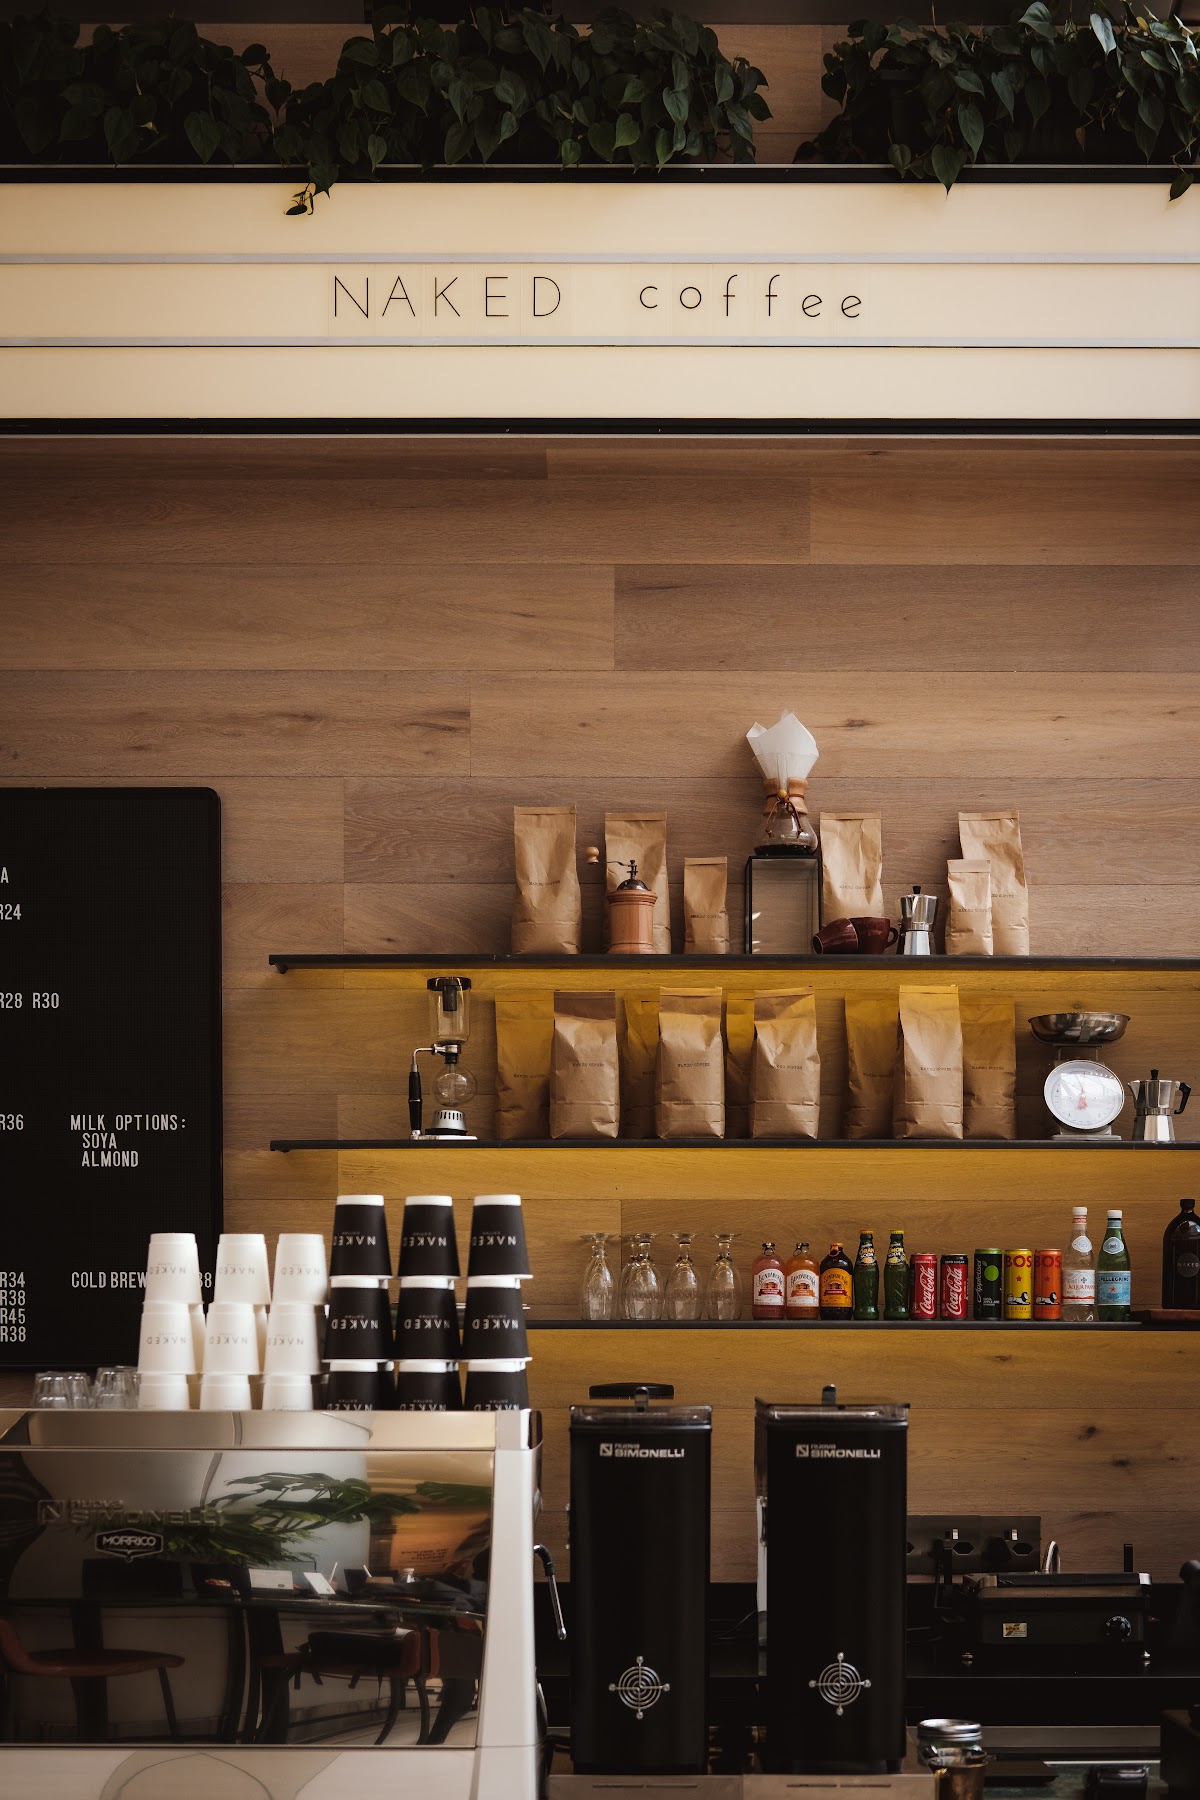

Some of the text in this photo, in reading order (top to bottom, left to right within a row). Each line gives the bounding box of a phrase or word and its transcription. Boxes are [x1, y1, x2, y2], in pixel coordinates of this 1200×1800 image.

[334, 274, 862, 318] NAKED coffee
[32, 992, 60, 1009] R30
[0, 1113, 24, 1131] R36
[70, 1114, 186, 1131] MILK OPTIONS:
[82, 1132, 117, 1149] SOYA
[81, 1150, 139, 1168] ALMOND
[1005, 1255, 1032, 1268] BOS
[1035, 1255, 1060, 1268] BOS
[0, 1271, 26, 1288] R34
[71, 1271, 106, 1288] COLD
[110, 1271, 148, 1288] BREW
[0, 1290, 26, 1306] R38
[0, 1308, 26, 1324] R45
[331, 1318, 378, 1330] NAKED
[404, 1318, 450, 1330] NAKED
[472, 1318, 518, 1330] NAKED
[0, 1326, 26, 1342] R38
[614, 1448, 684, 1458] SIMONELLI
[811, 1449, 881, 1458] SIMONELLI
[102, 1536, 156, 1546] MORRICO
